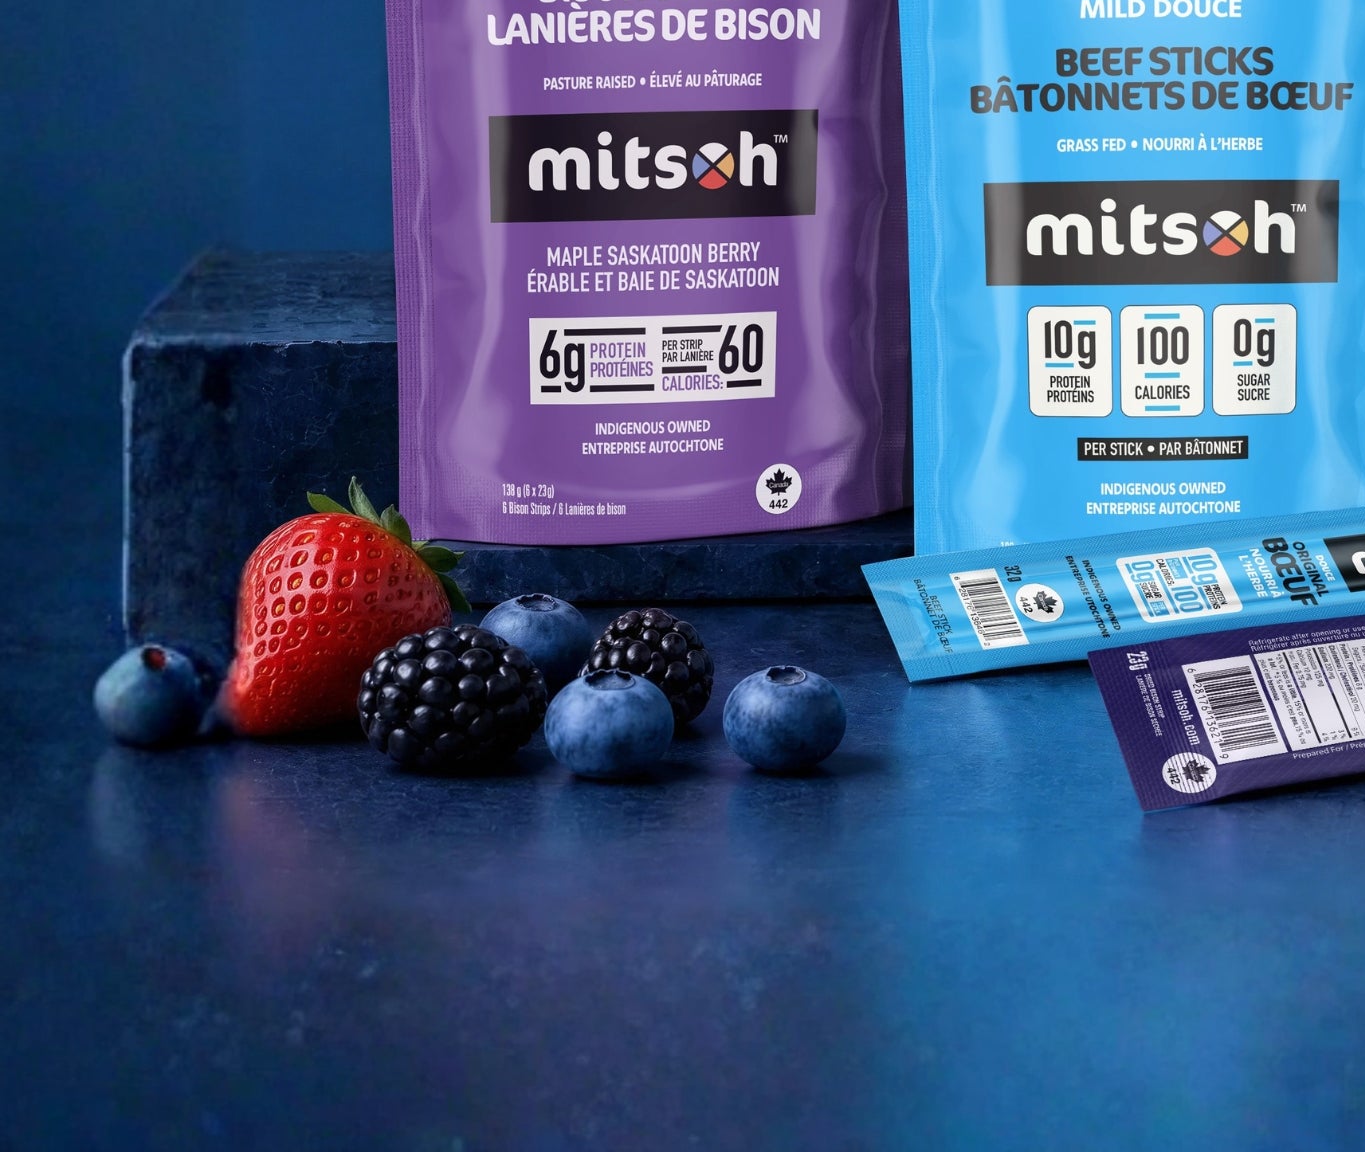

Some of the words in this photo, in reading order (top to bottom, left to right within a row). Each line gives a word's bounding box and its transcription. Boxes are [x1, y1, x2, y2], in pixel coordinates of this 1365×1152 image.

[487, 3, 655, 46] LANIÈRES
[662, 9, 708, 40] DE
[715, 7, 821, 39] BISON
[1055, 47, 1142, 77] BEEF
[1149, 45, 1274, 76] STICKS
[543, 75, 593, 90] PASTURE
[596, 74, 636, 89] RAISED
[649, 69, 683, 88] ÉLEVÉ
[685, 72, 701, 87] AU
[704, 69, 762, 87] PÂTURAGE
[970, 75, 1184, 113] BÂTONNETS
[1192, 81, 1237, 110] DE
[1057, 137, 1097, 152] GRASS
[1101, 137, 1126, 151] FED
[1142, 136, 1194, 150] NOURRI
[1197, 131, 1208, 150] À
[546, 245, 603, 267] MAPLE
[607, 243, 703, 266] SASKATOON
[707, 241, 760, 263] BERRY
[590, 342, 646, 358] PROTEIN
[719, 323, 764, 373] 60
[1137, 325, 1189, 365] 100
[590, 357, 654, 377] PROTÉINES
[1049, 375, 1090, 388] PROTEIN
[1237, 373, 1271, 386] SUGAR
[1047, 387, 1094, 402] PROTÉINS
[1135, 383, 1190, 400] CALORIES
[1237, 387, 1270, 400] SUCRE
[595, 420, 665, 435] INDIGENOUS
[667, 418, 710, 433] OWNED
[582, 439, 647, 454] ENTREPRISE
[649, 437, 724, 452] AUTOCHTONE
[1084, 441, 1107, 455] PER
[1110, 440, 1143, 455] STICK
[1159, 440, 1184, 454] PAR
[1186, 436, 1243, 454] BÂTONNET
[768, 497, 789, 509] 442
[1171, 688, 1201, 745] mitsoh.com
